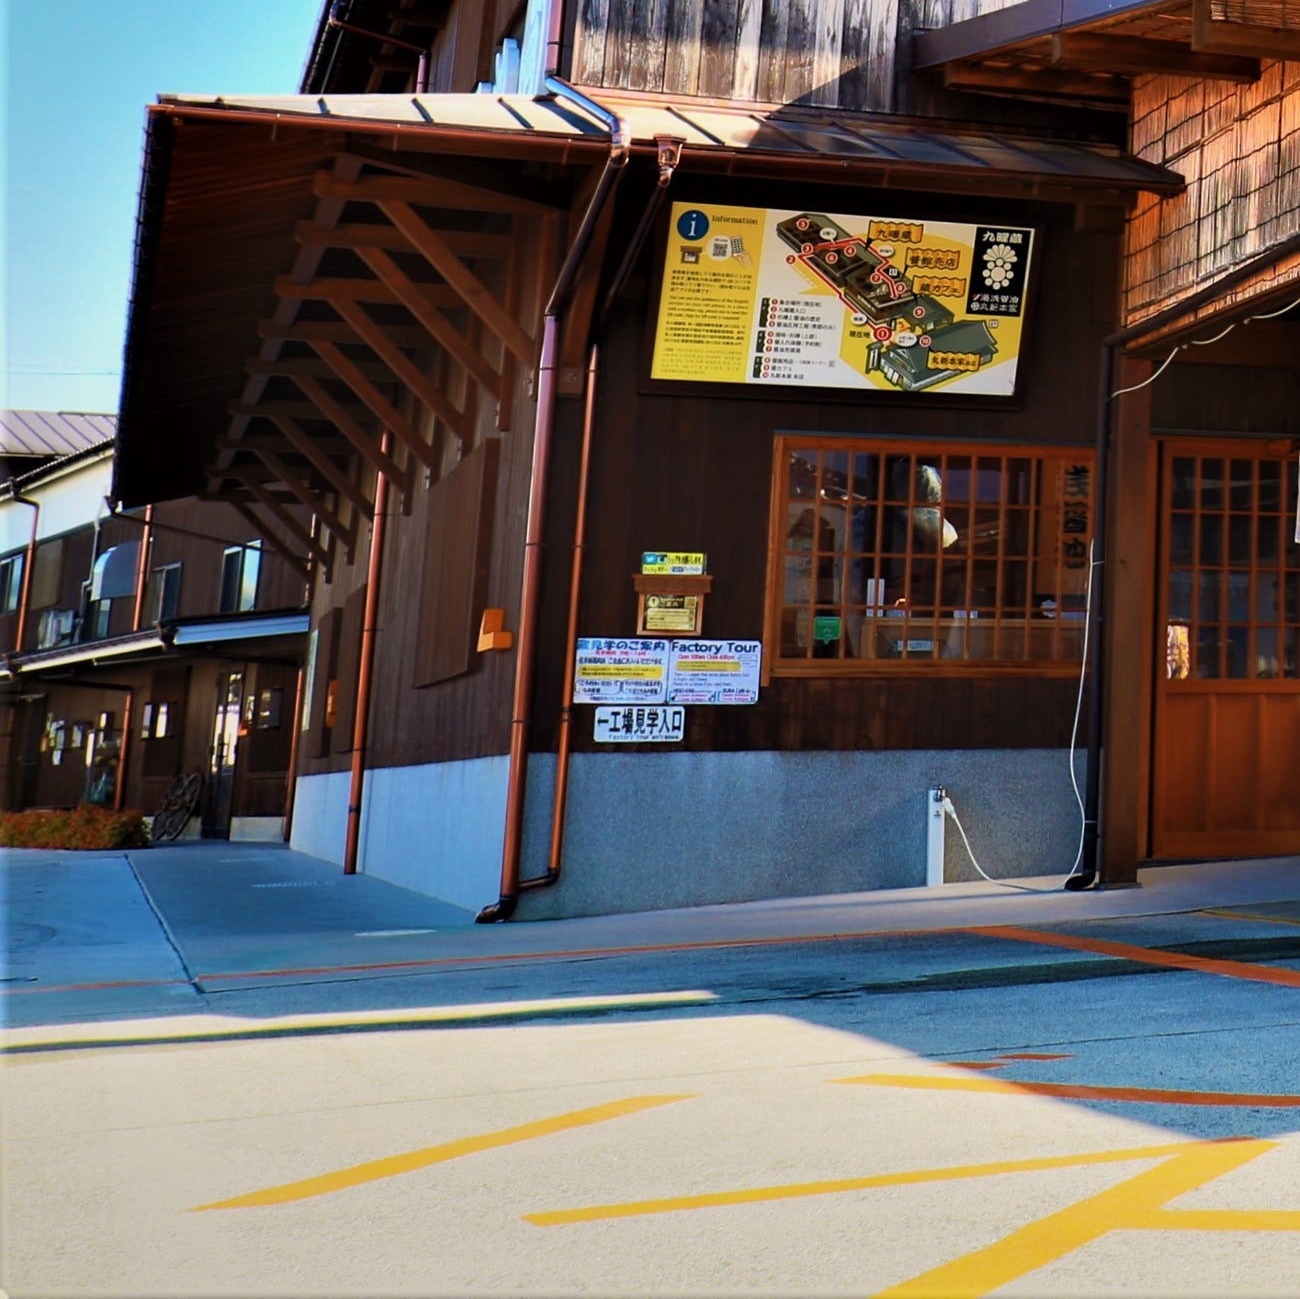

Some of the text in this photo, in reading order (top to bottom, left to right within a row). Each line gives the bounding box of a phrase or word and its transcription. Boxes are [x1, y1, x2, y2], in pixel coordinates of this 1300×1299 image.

[711, 214, 758, 225] Information
[982, 230, 1023, 244] 九曜蔵
[672, 641, 758, 655] Factory Tour
[608, 708, 682, 735] 工場見学入口
